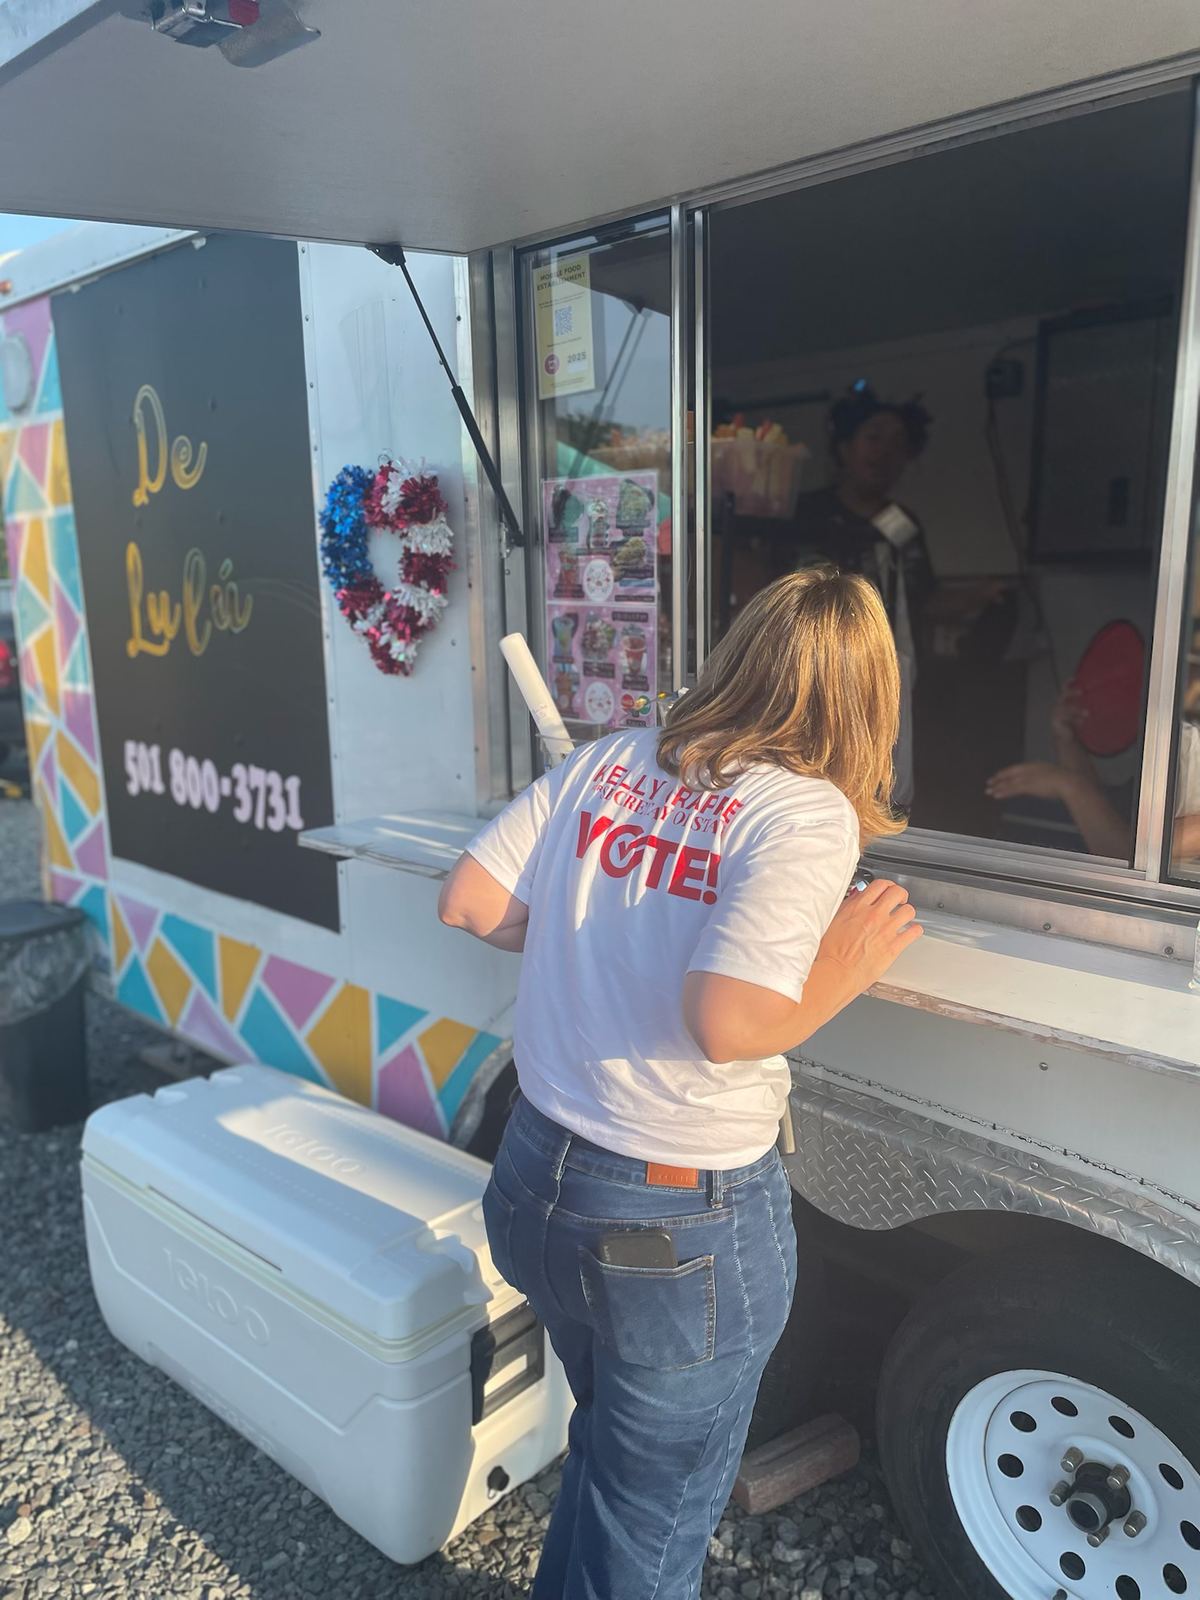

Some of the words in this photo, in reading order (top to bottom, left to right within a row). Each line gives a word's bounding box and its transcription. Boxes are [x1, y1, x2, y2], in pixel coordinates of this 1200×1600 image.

[537, 272, 586, 291] ESTAHMENT
[564, 264, 582, 275] FOOD
[567, 352, 587, 363] 2025
[132, 384, 207, 507] De
[125, 740, 165, 796] 501
[169, 748, 304, 832] 800-3731
[593, 764, 668, 801] KELLY
[666, 784, 744, 824] RAPE
[576, 811, 721, 905] VOTE!
